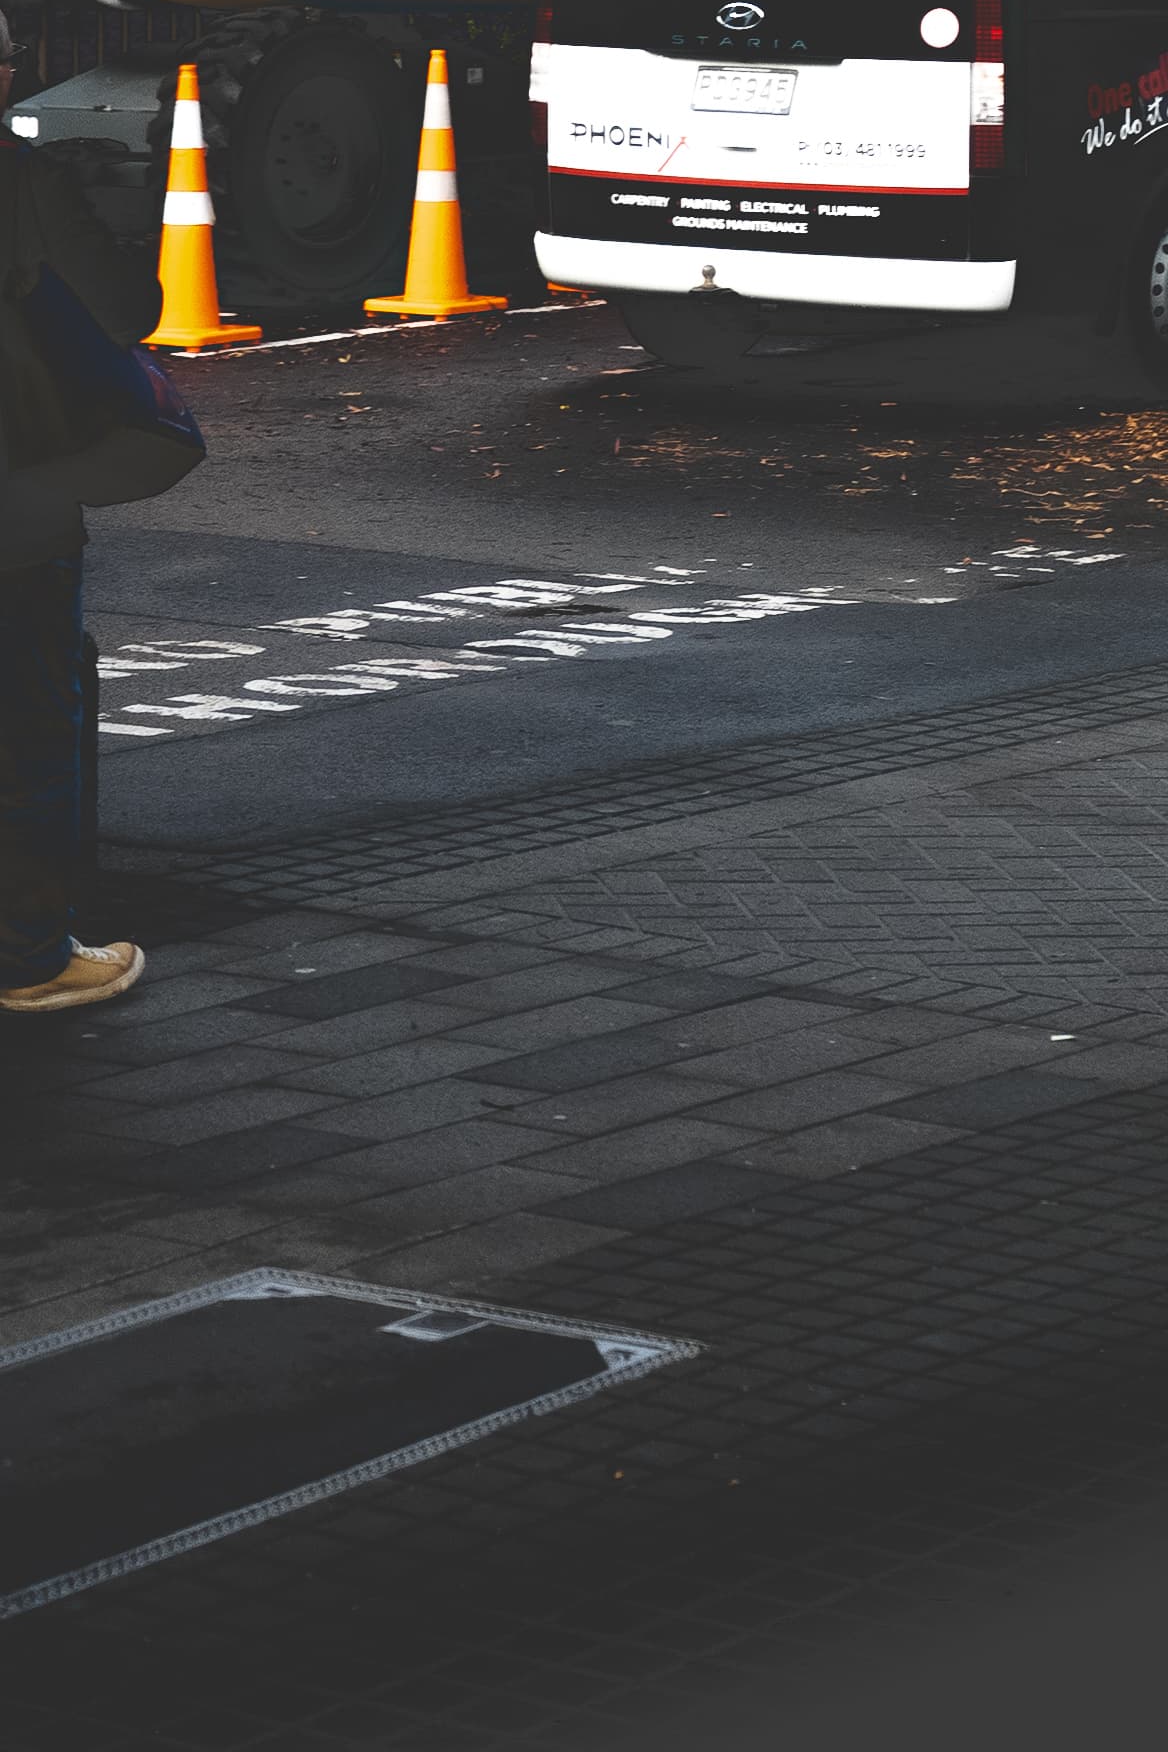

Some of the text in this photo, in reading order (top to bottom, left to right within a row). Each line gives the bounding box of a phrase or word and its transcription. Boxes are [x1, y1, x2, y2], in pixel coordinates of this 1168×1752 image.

[671, 34, 808, 50] STARIA
[1087, 82, 1132, 118] One
[1081, 117, 1116, 154] We
[1120, 107, 1142, 140] do
[1146, 96, 1163, 126] it
[740, 200, 809, 215] ELECTRICAL
[672, 215, 725, 230] GROUNDS
[248, 559, 752, 642] PUBLI
